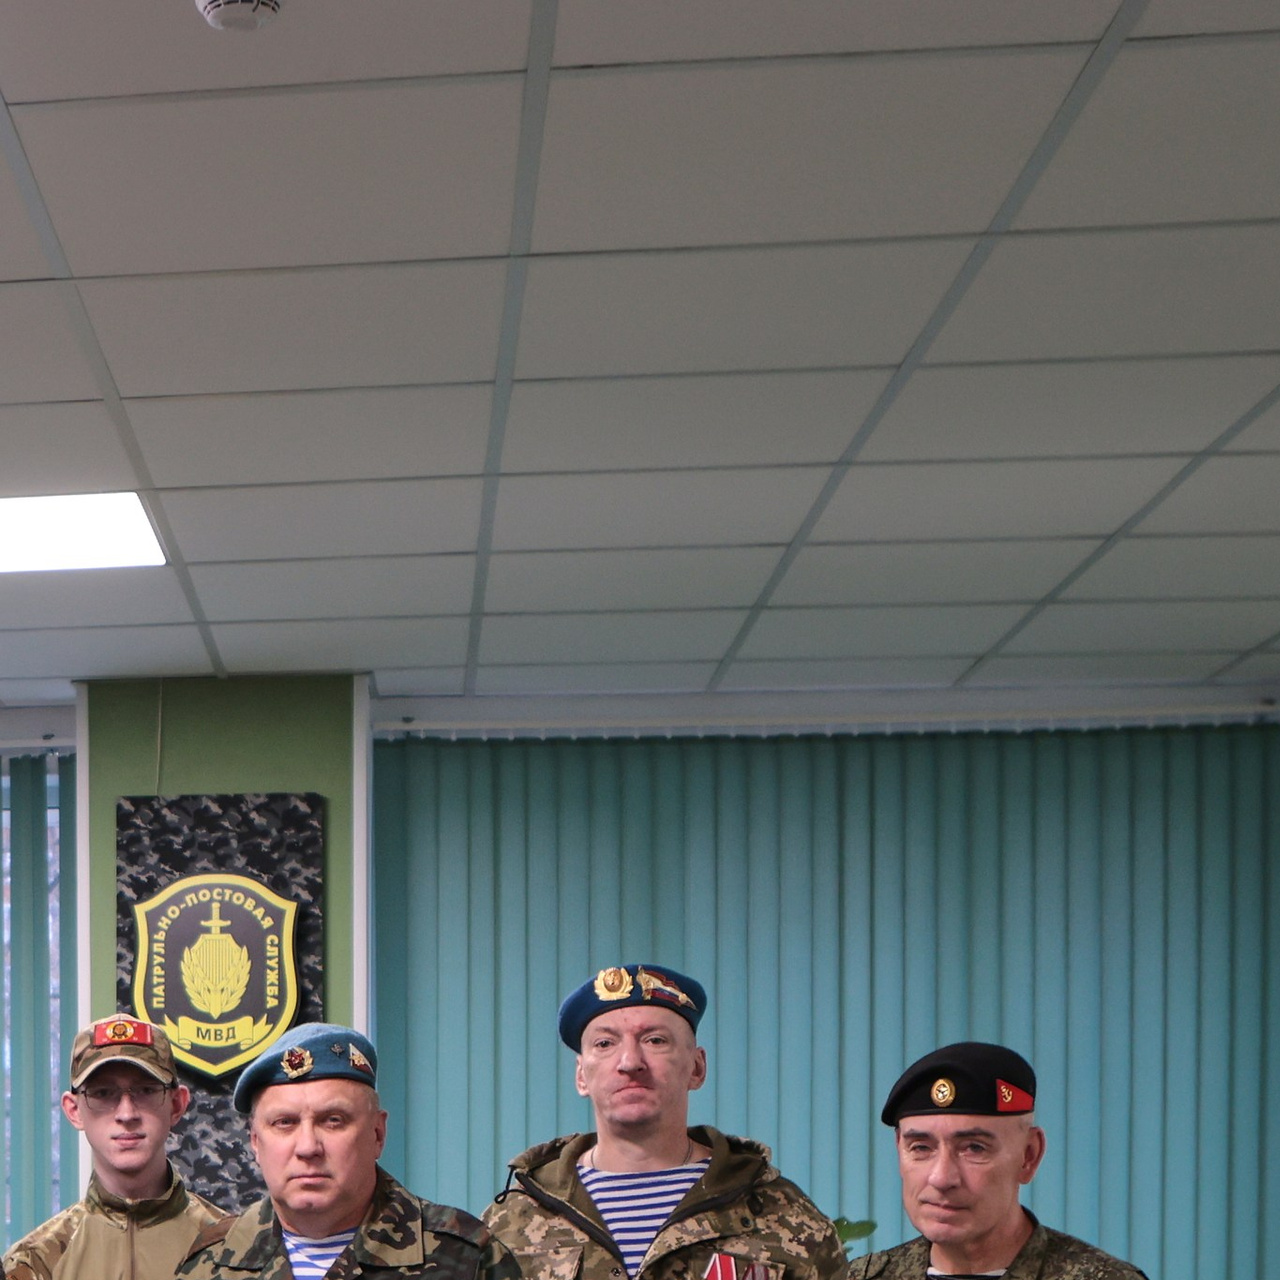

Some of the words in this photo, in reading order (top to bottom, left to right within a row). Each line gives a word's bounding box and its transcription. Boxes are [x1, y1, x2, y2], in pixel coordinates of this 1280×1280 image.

[152, 887, 274, 1009] ПАТРУЛЬНО-ПОСТОВАЯ
[265, 934, 279, 1009] СЛУЖБА
[195, 1026, 237, 1042] МВД
